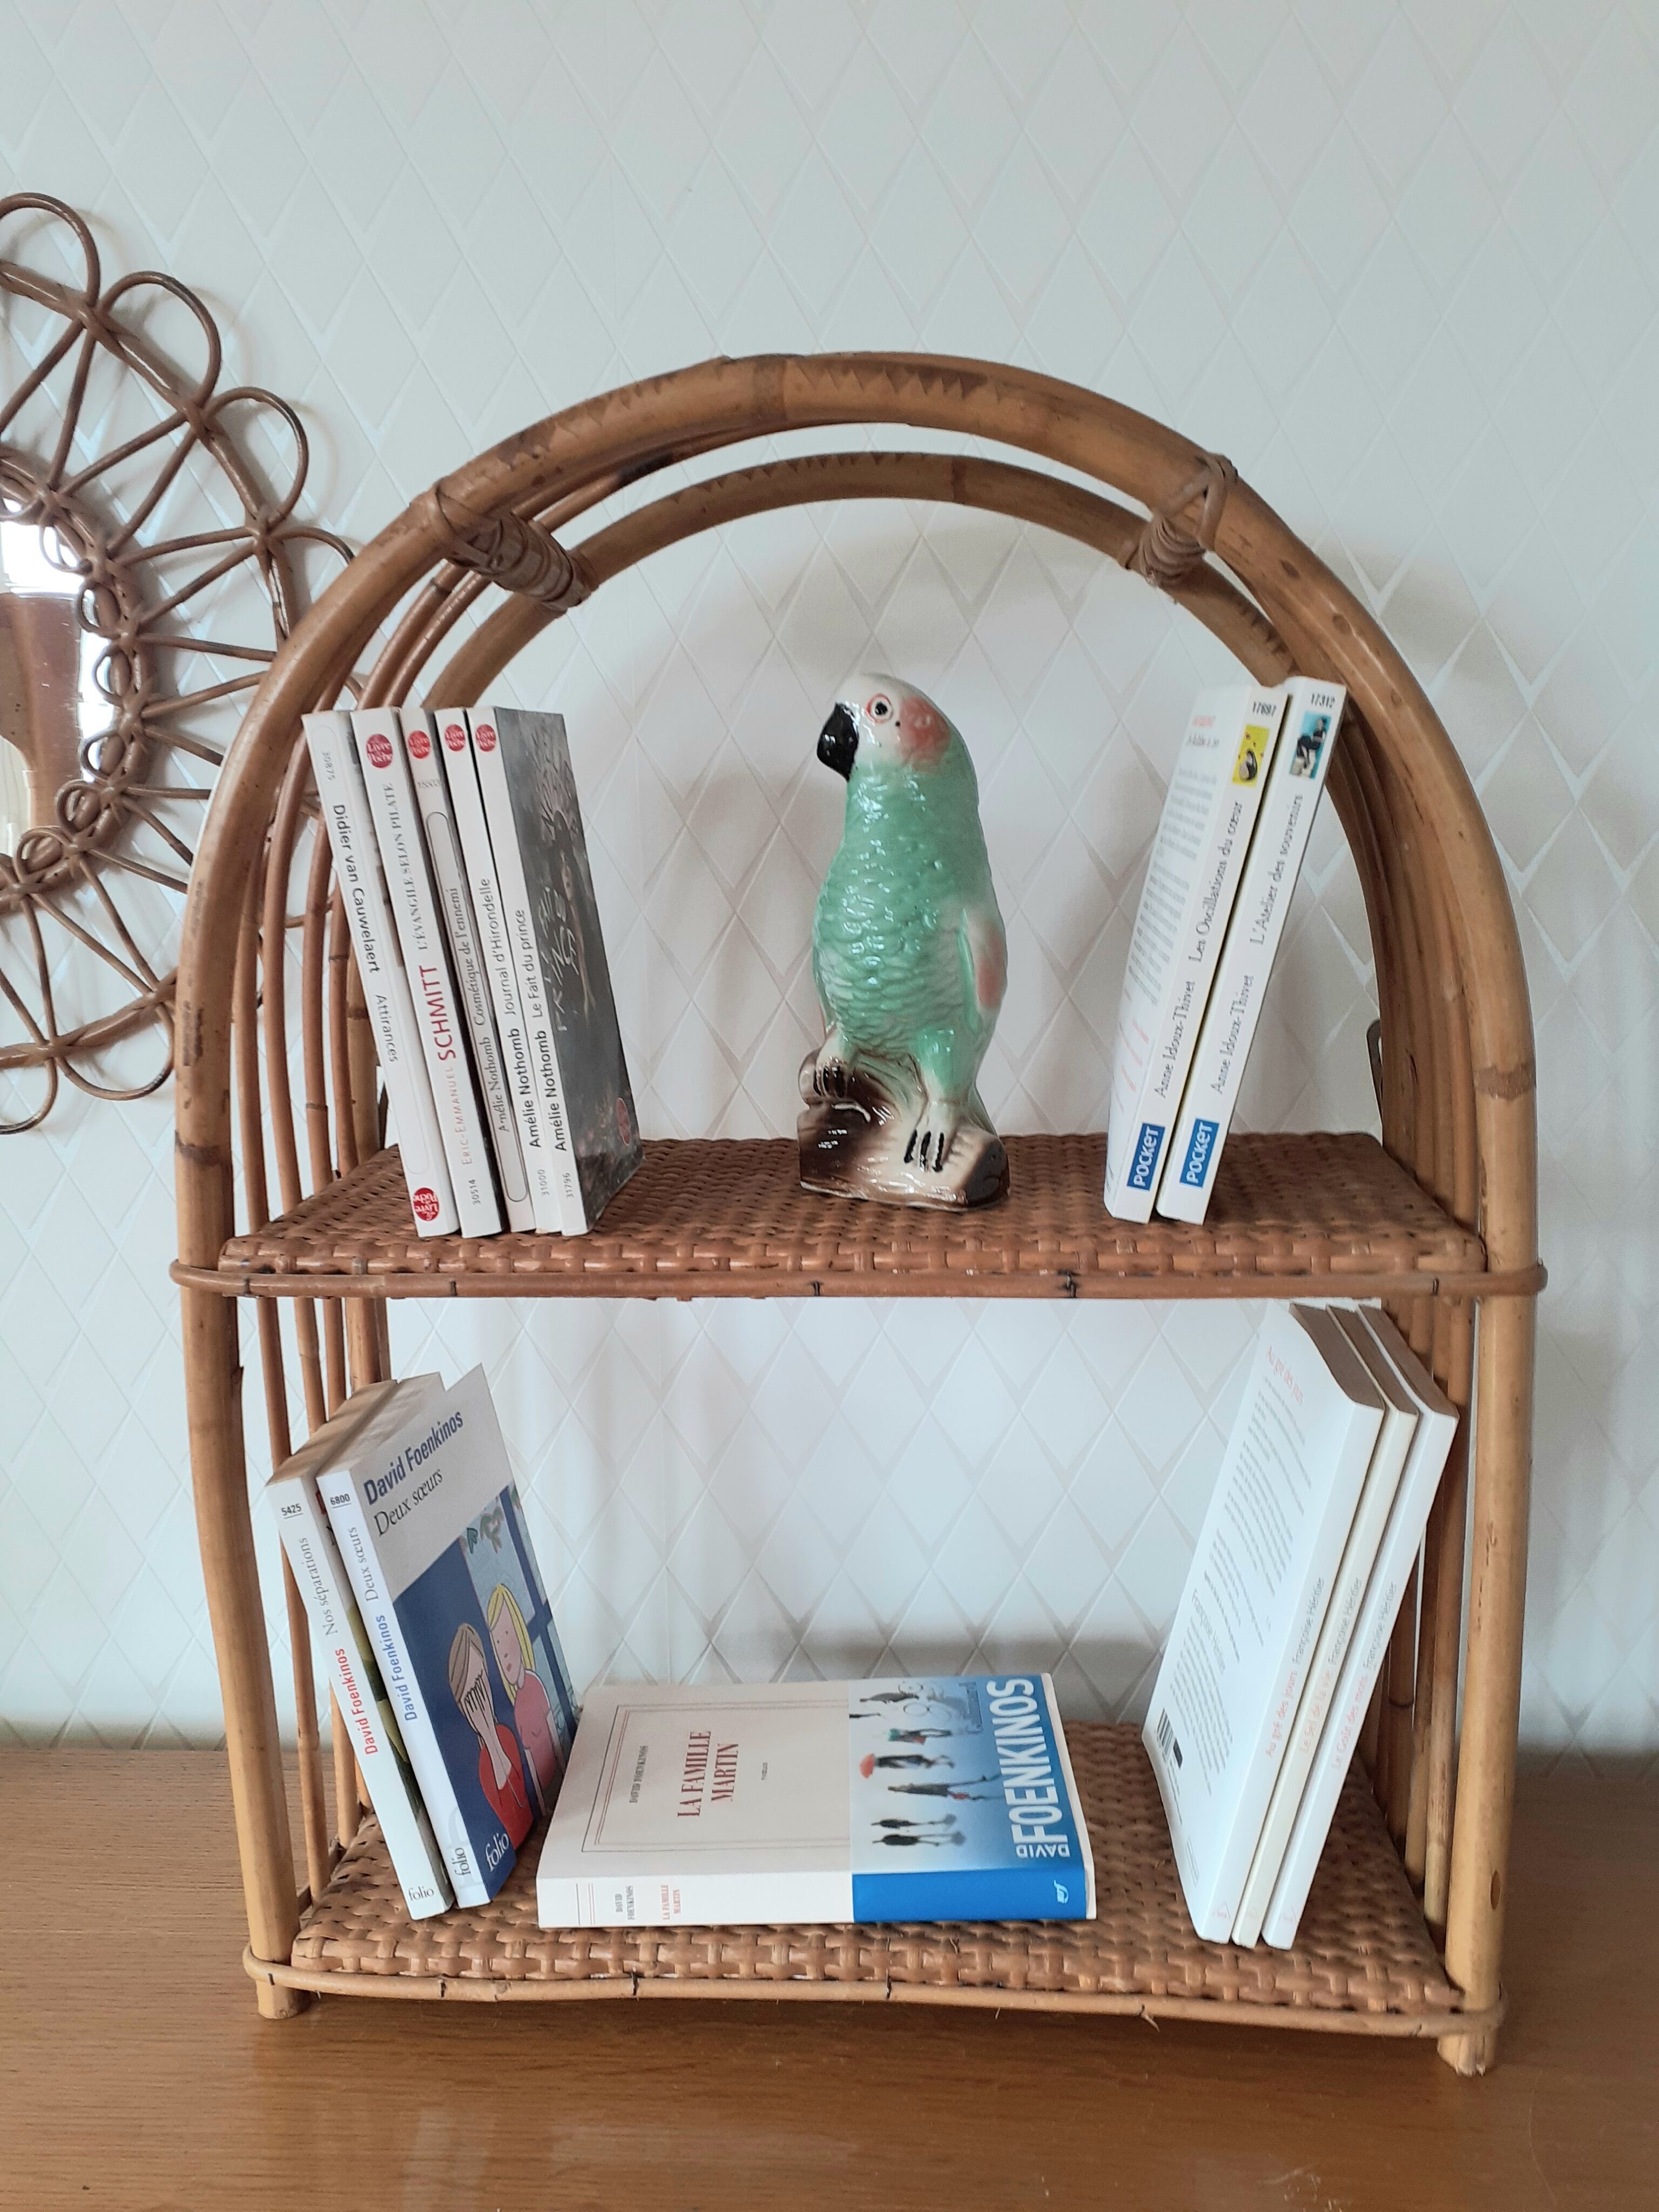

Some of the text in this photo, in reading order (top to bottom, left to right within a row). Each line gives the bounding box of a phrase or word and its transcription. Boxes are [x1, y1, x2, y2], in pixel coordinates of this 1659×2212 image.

[382, 783, 401, 830] PILATE
[394, 832, 410, 875] SELON
[1217, 837, 1233, 858] du
[1195, 858, 1228, 936] Oscillations
[333, 804, 399, 1062] Didier van Cauwelaert Attirances
[1189, 939, 1206, 963] Les
[1210, 1059, 1230, 1095] Anne
[1250, 885, 1278, 945] L'Atelier
[1267, 859, 1285, 882] des
[1280, 793, 1303, 856] souvenirs
[419, 965, 456, 1061] SCHMITT
[445, 888, 509, 1132] Amélie Nothomb Cosmétique de l'ennemi
[480, 878, 542, 1148] Amélie Nothomb Journal d'Hirondelle
[515, 909, 568, 1152] Amélie Nothomb Le Fait du prince
[1155, 1064, 1174, 1098] Anne
[1134, 1125, 1159, 1187] POCKET
[1186, 1122, 1213, 1184] POCKET
[468, 1179, 481, 1205] 30514
[537, 1169, 550, 1196] 31000
[363, 1411, 464, 1505] David Foenkinos
[281, 1503, 302, 1516] 5425
[330, 1493, 350, 1505] 6800
[374, 1500, 411, 1538] Deux
[358, 1567, 379, 1602] Deux
[299, 1537, 379, 1755] David Foenkinos Nos séparations
[375, 1615, 403, 1683] Foenkinos
[1328, 1617, 1350, 1665] Françoise
[396, 1684, 417, 1722] David
[1265, 1742, 1276, 1757] Au
[1276, 1701, 1289, 1718] des
[1292, 1617, 1313, 1664] Françoise
[677, 1731, 711, 1817] LA FAMILLE
[711, 1743, 739, 1802] MARTIN
[986, 1678, 1068, 1844] FOENKINOS
[454, 1847, 471, 1877] folio
[486, 1832, 509, 1873] folio
[1016, 1844, 1070, 1858] DAVID
[408, 1887, 435, 1902] folio
